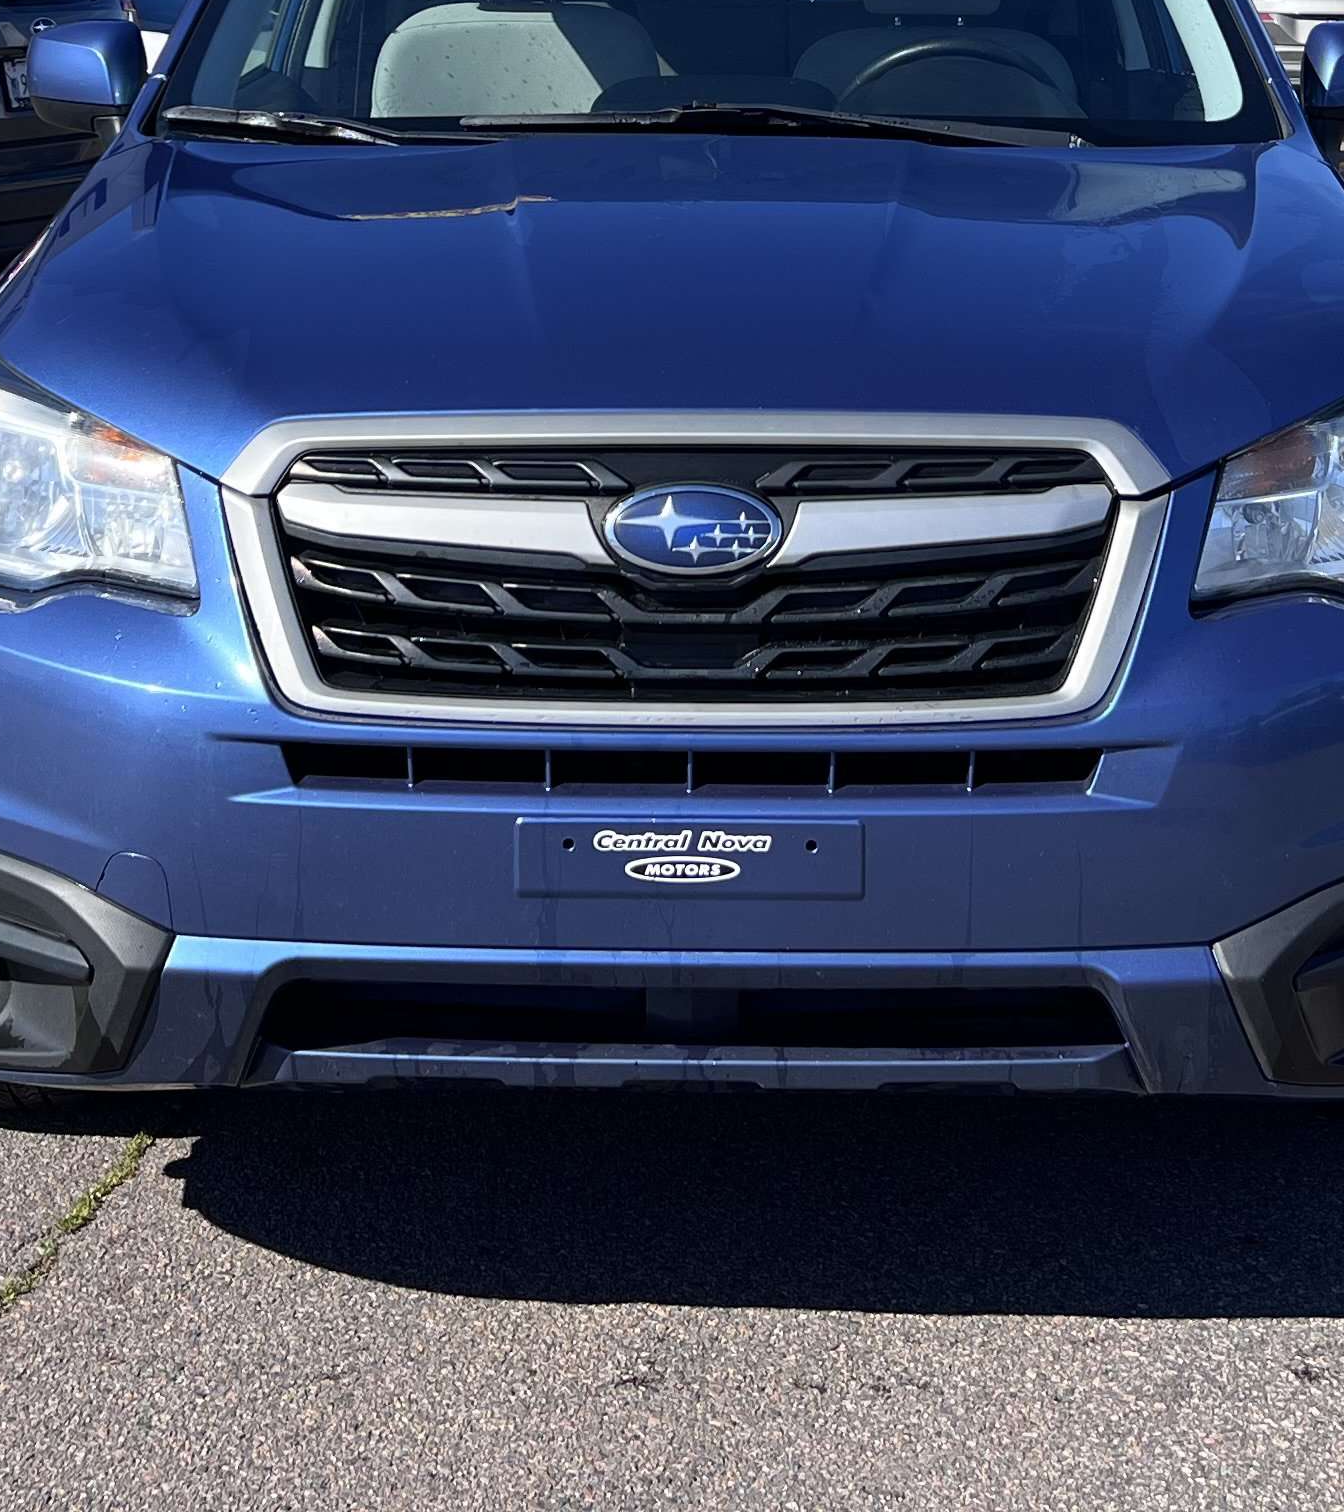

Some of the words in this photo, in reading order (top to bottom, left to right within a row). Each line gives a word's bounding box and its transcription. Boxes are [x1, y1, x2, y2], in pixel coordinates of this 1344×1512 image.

[593, 830, 691, 852] Central
[697, 830, 773, 853] Nova
[644, 863, 721, 877] MOTORS
